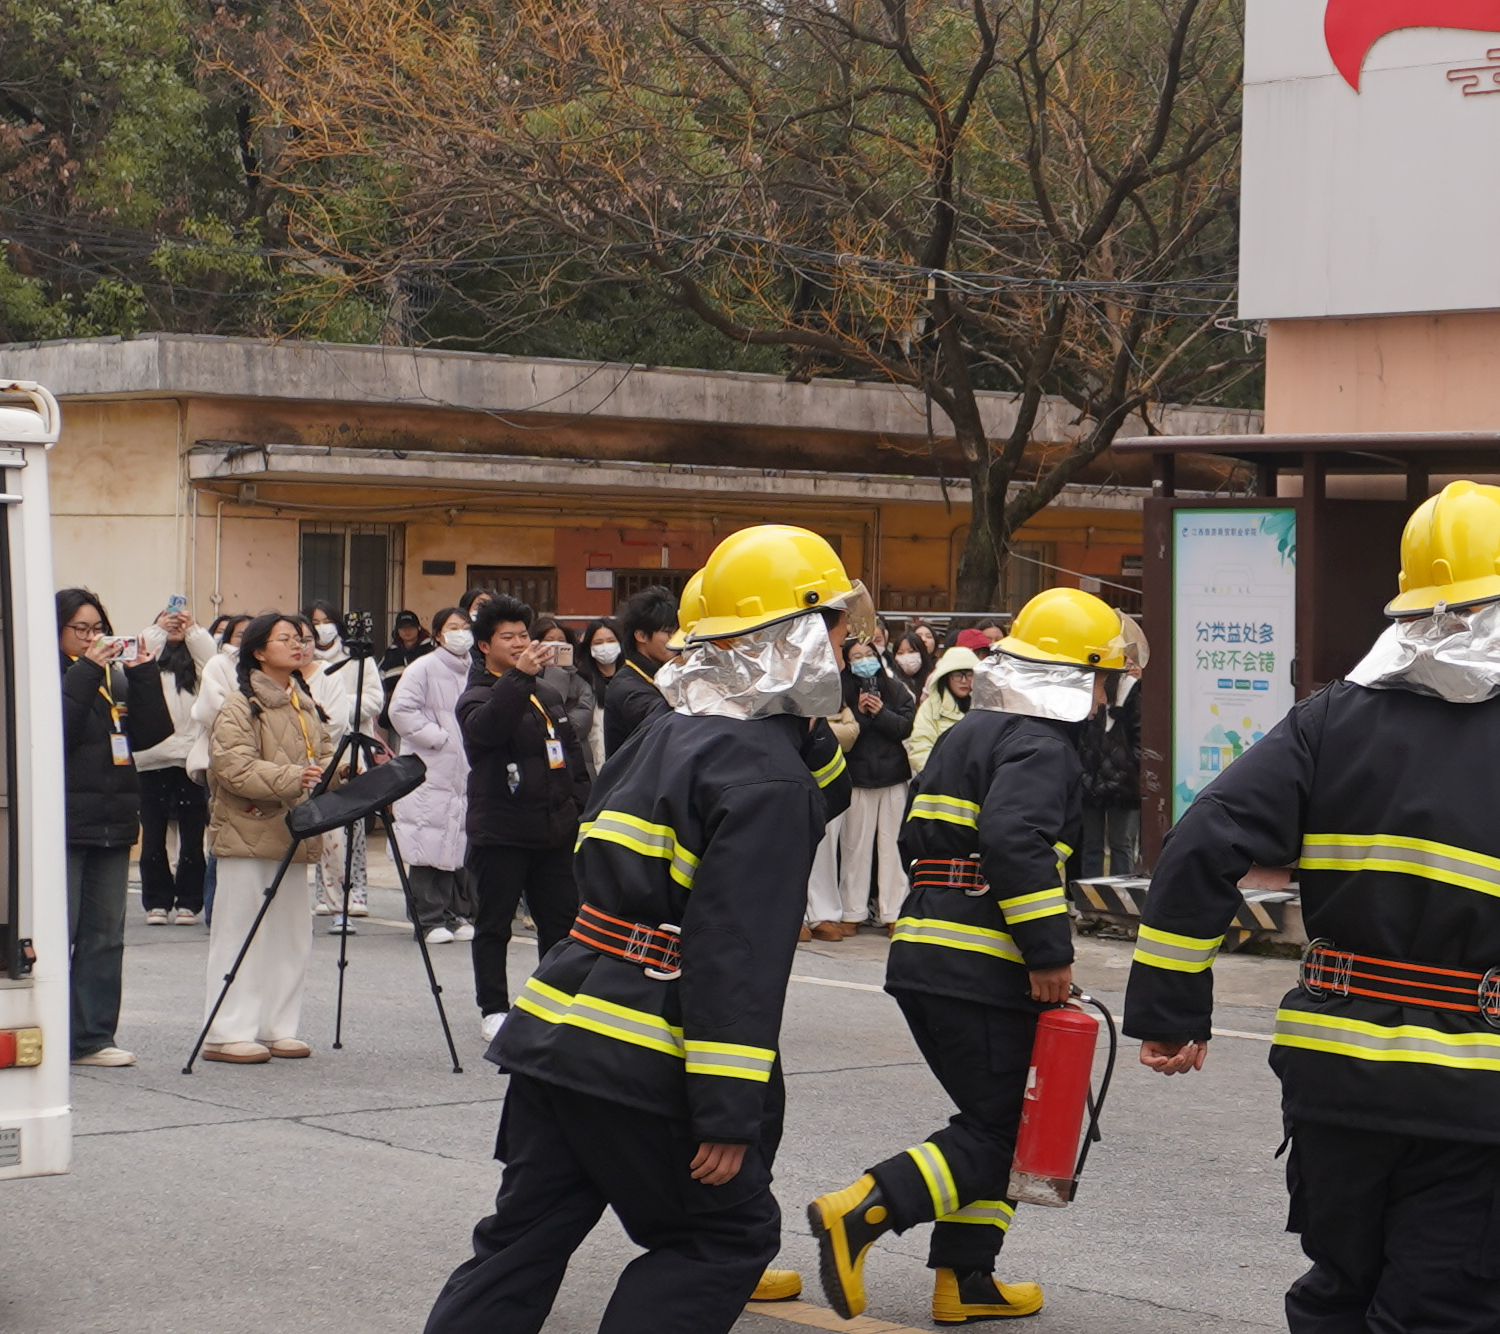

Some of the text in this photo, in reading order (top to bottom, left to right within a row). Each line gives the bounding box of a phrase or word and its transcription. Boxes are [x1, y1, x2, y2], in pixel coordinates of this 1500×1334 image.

[1195, 620, 1274, 645] 分类益处多
[1195, 648, 1276, 673] 分好不会错
